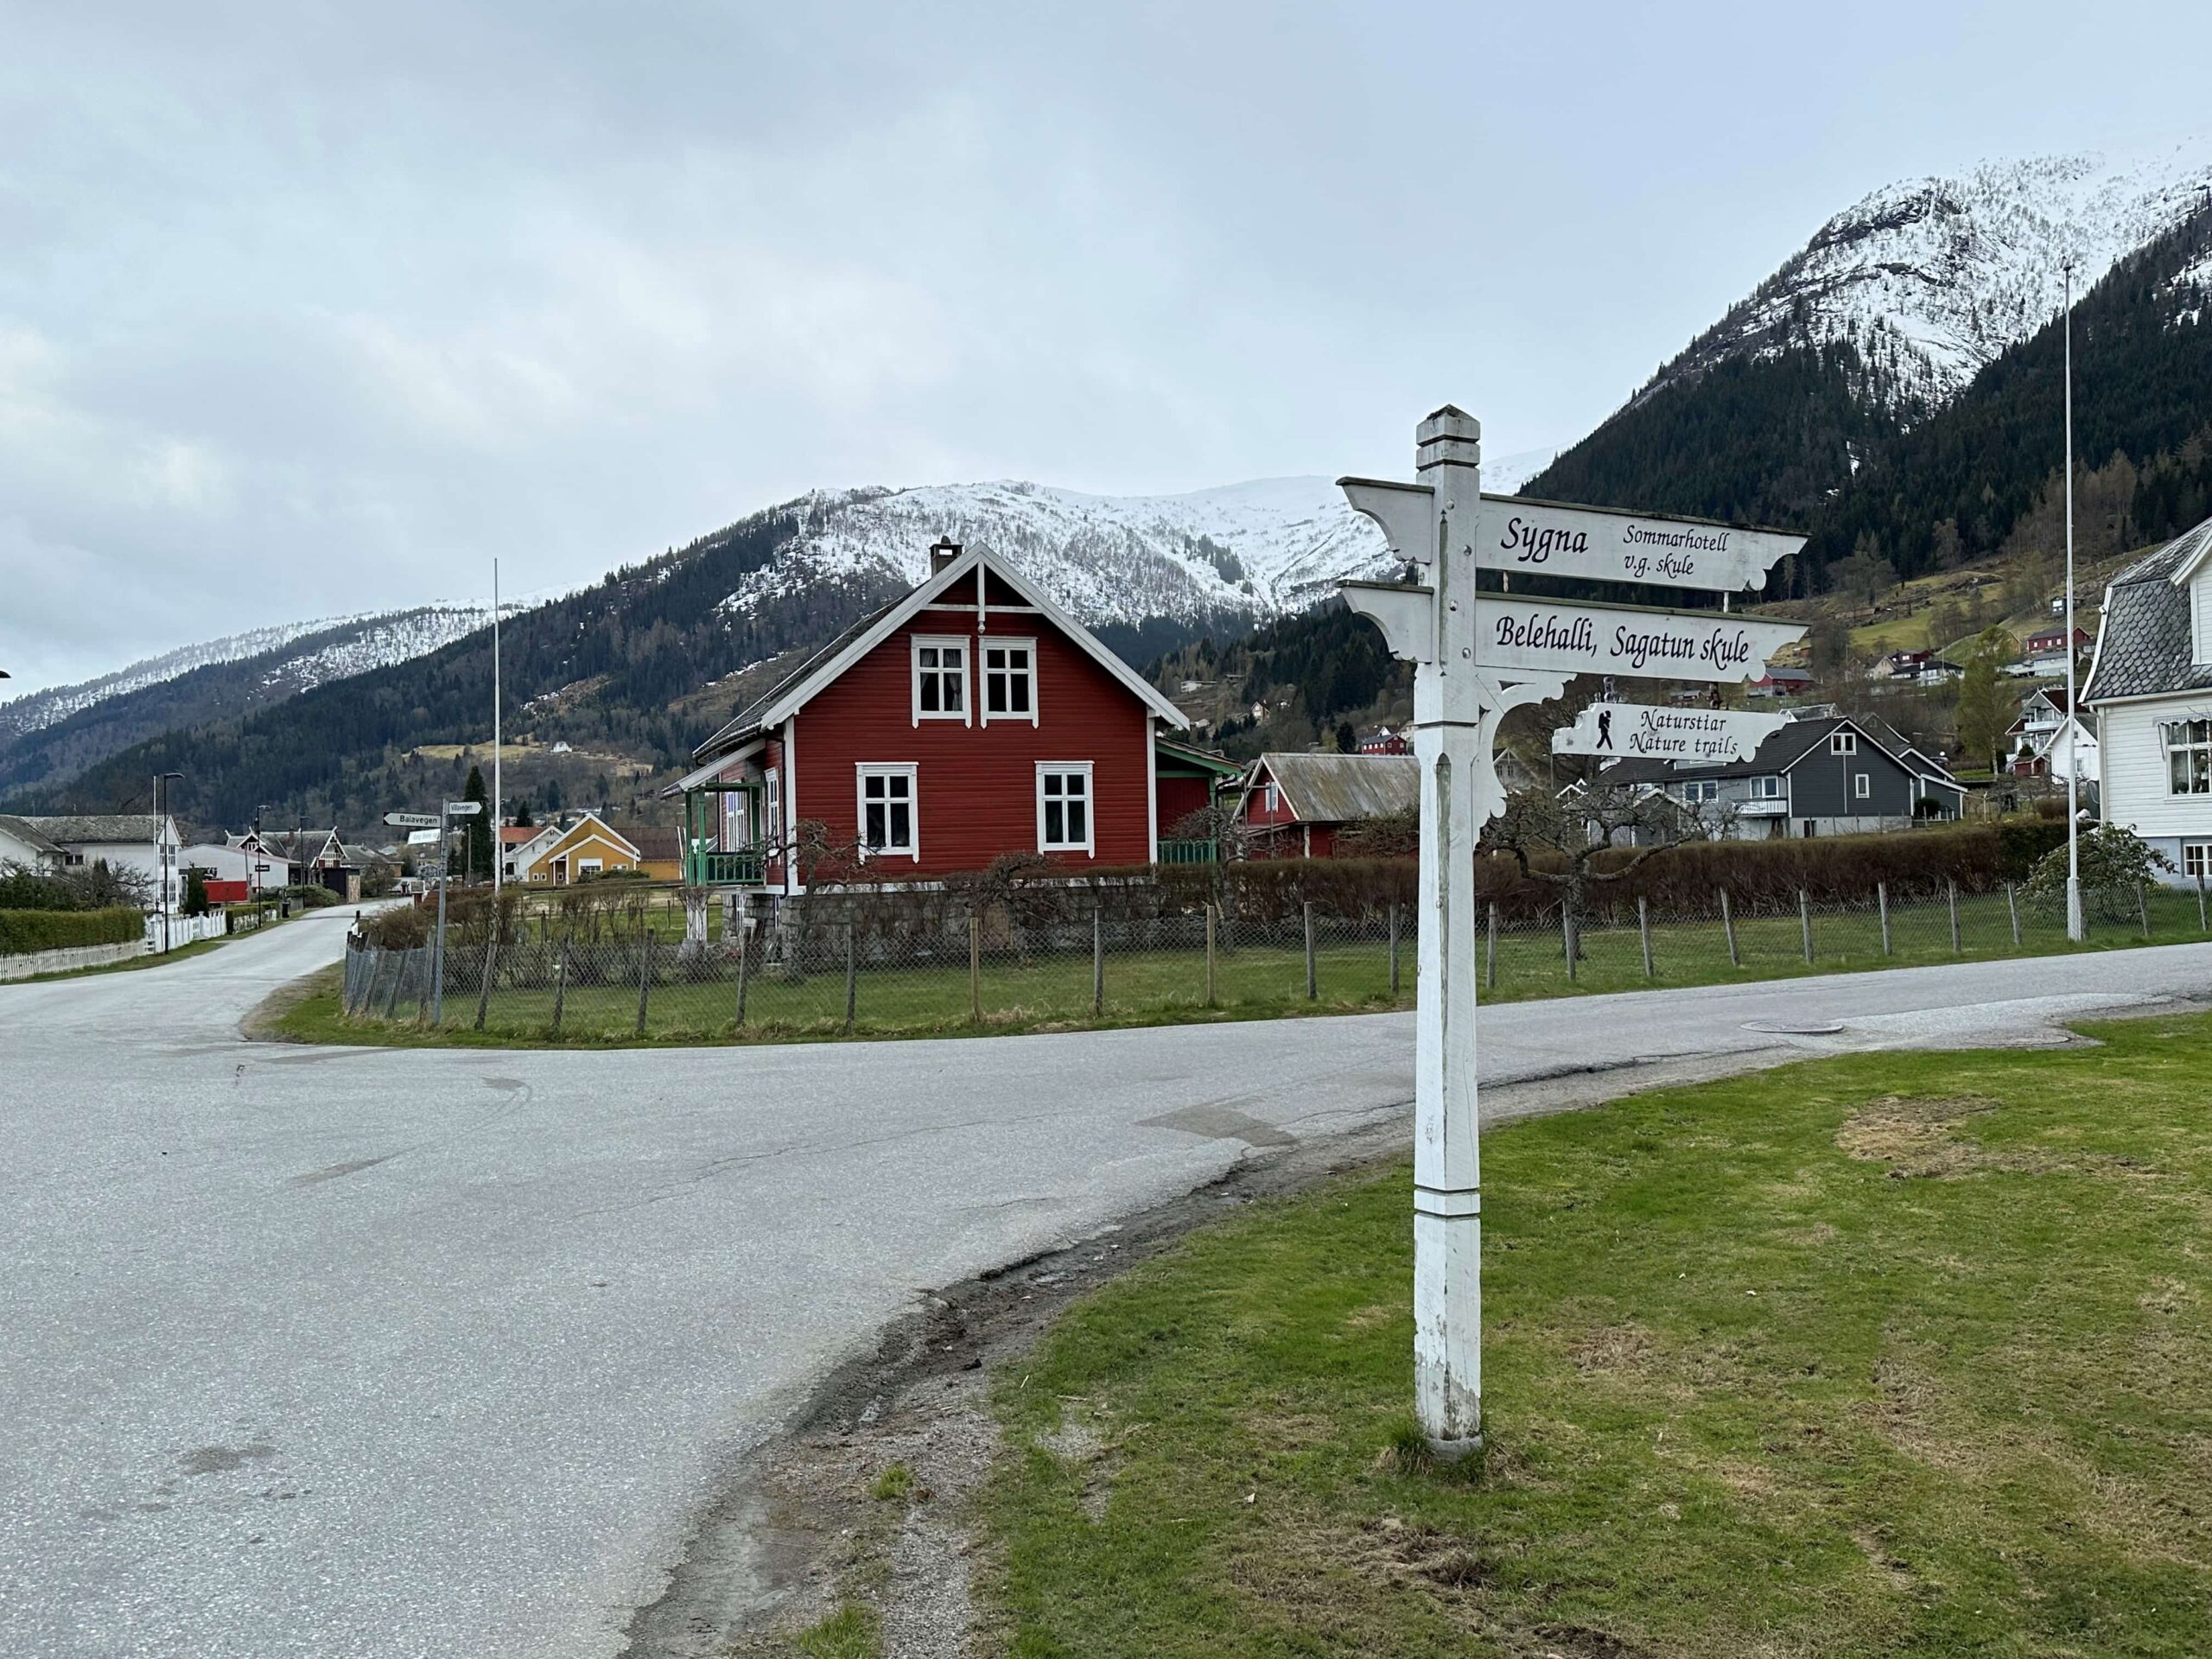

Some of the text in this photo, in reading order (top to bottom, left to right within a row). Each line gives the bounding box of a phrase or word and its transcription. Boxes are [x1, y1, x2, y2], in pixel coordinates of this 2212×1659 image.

[1500, 517, 1588, 563] Sygna
[1623, 524, 1730, 552] Sommarhotell
[1624, 552, 1694, 578] v.g. skule
[1497, 613, 1749, 671] Belehalli, Sagatun skule
[1641, 709, 1726, 732] Naturstiar
[1629, 732, 1738, 754] Nature trails
